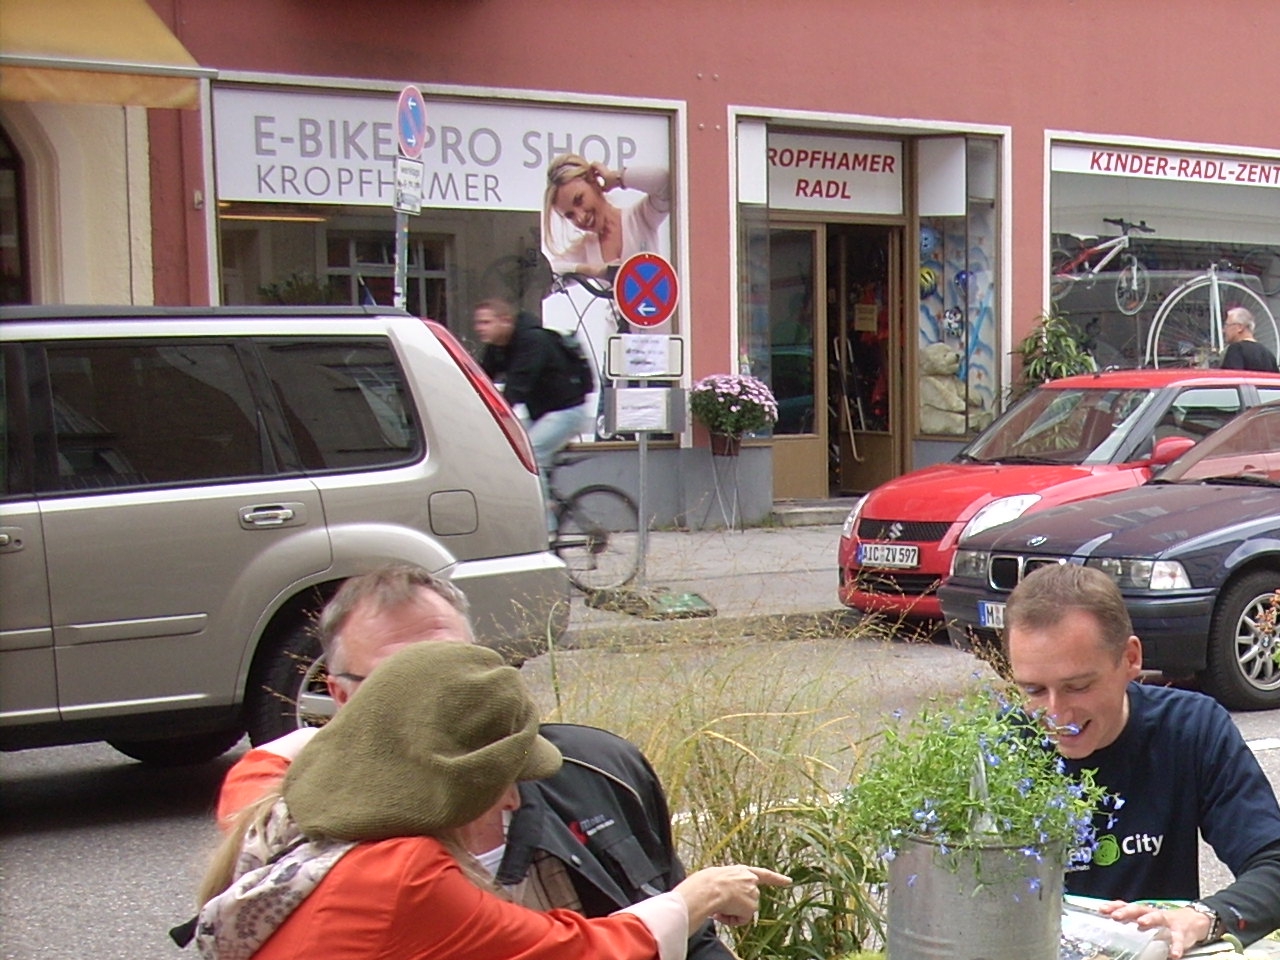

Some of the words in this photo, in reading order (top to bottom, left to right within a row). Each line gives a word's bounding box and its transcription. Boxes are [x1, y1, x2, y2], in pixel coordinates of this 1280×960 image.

[253, 115, 397, 162] E-BIKE
[522, 130, 637, 169] SHOP
[257, 164, 502, 203] KROPFHMER
[795, 179, 852, 199] RADL
[885, 547, 897, 562] ZV
[900, 549, 917, 564] 597
[1121, 833, 1164, 857] City
